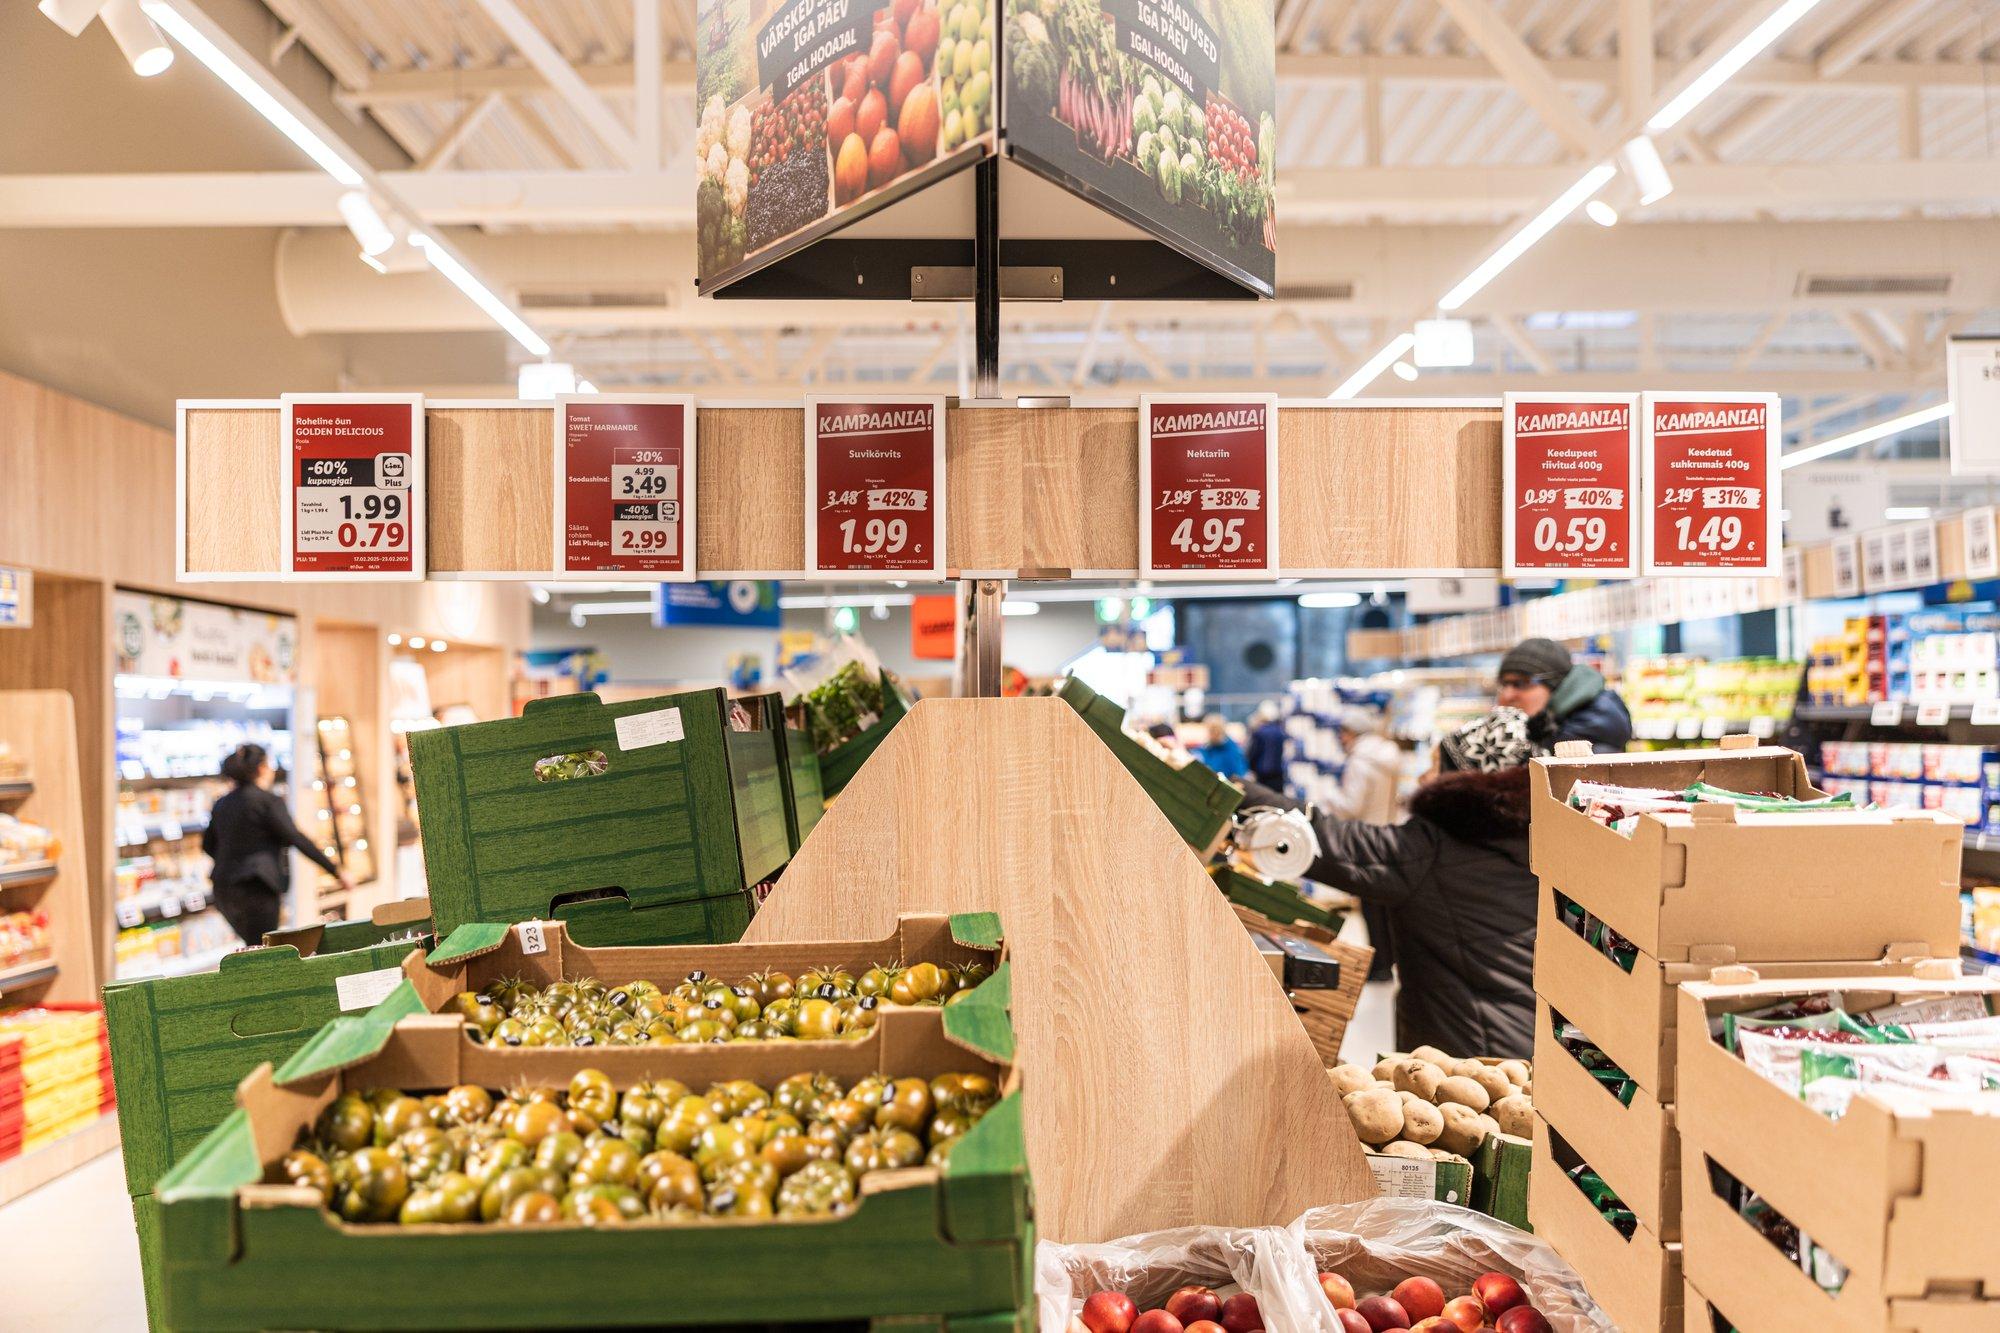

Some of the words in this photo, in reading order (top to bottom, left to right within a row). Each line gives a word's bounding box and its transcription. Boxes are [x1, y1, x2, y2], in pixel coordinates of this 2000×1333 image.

[760, 0, 814, 59] VÄRSKED
[793, 20, 816, 52] IGA
[816, 0, 849, 33] PÄEV
[1137, 0, 1159, 32] IGA
[1160, 18, 1188, 55] PÄEV
[1160, 0, 1217, 63] SAADUSED
[786, 58, 809, 88] IGAL
[810, 28, 857, 69] HOOAJAL
[1130, 31, 1153, 59] IGAL
[1153, 45, 1194, 93] HOOAJAL
[295, 417, 333, 425] Roheline
[334, 417, 352, 425] õun
[820, 409, 932, 432] KAMPAANIA!
[1153, 409, 1265, 432] KAMPAANIA!
[1517, 408, 1629, 431] KAMPAANIA!
[1656, 408, 1766, 431] KAMPAANIA!
[295, 427, 333, 436] GOLDEN
[335, 427, 384, 436] DELICIOUS
[632, 451, 663, 463] -30%
[849, 450, 901, 459] Suvikõrvits
[1187, 449, 1230, 458] Nektariin
[1547, 449, 1597, 459] Keedupeet
[1688, 448, 1732, 457] Keedetud
[307, 460, 348, 475] -60%
[635, 467, 654, 476] 4.99
[1542, 461, 1576, 469] riivitud
[1578, 461, 1603, 471] 400g
[1670, 460, 1724, 469] suhkrumais
[1725, 460, 1750, 471] 400g
[307, 476, 353, 486] kupongiga!
[384, 479, 402, 487] Plus
[622, 476, 667, 494] 3.49
[827, 490, 859, 505] 3.48
[873, 491, 915, 507] -42%
[1162, 490, 1193, 505] 7.99
[1207, 491, 1248, 506] -38%
[1524, 489, 1557, 504] 0.99
[1570, 490, 1612, 505] -40%
[1664, 488, 1695, 503] 2.19
[1710, 490, 1748, 505] -31%
[339, 494, 401, 519] 1.99
[625, 505, 649, 514] -40%
[338, 522, 404, 548] 0.79
[622, 531, 667, 549] 2.99
[840, 518, 908, 553] 1.99
[914, 543, 921, 553] €
[1170, 518, 1245, 553] 4.95
[1247, 543, 1255, 552] €
[1534, 517, 1606, 552] 0.59
[1610, 542, 1618, 551] €
[1675, 516, 1742, 551] 1.49
[1747, 541, 1755, 551] €
[583, 540, 610, 548] Plusiga:
[526, 927, 540, 951] 323
